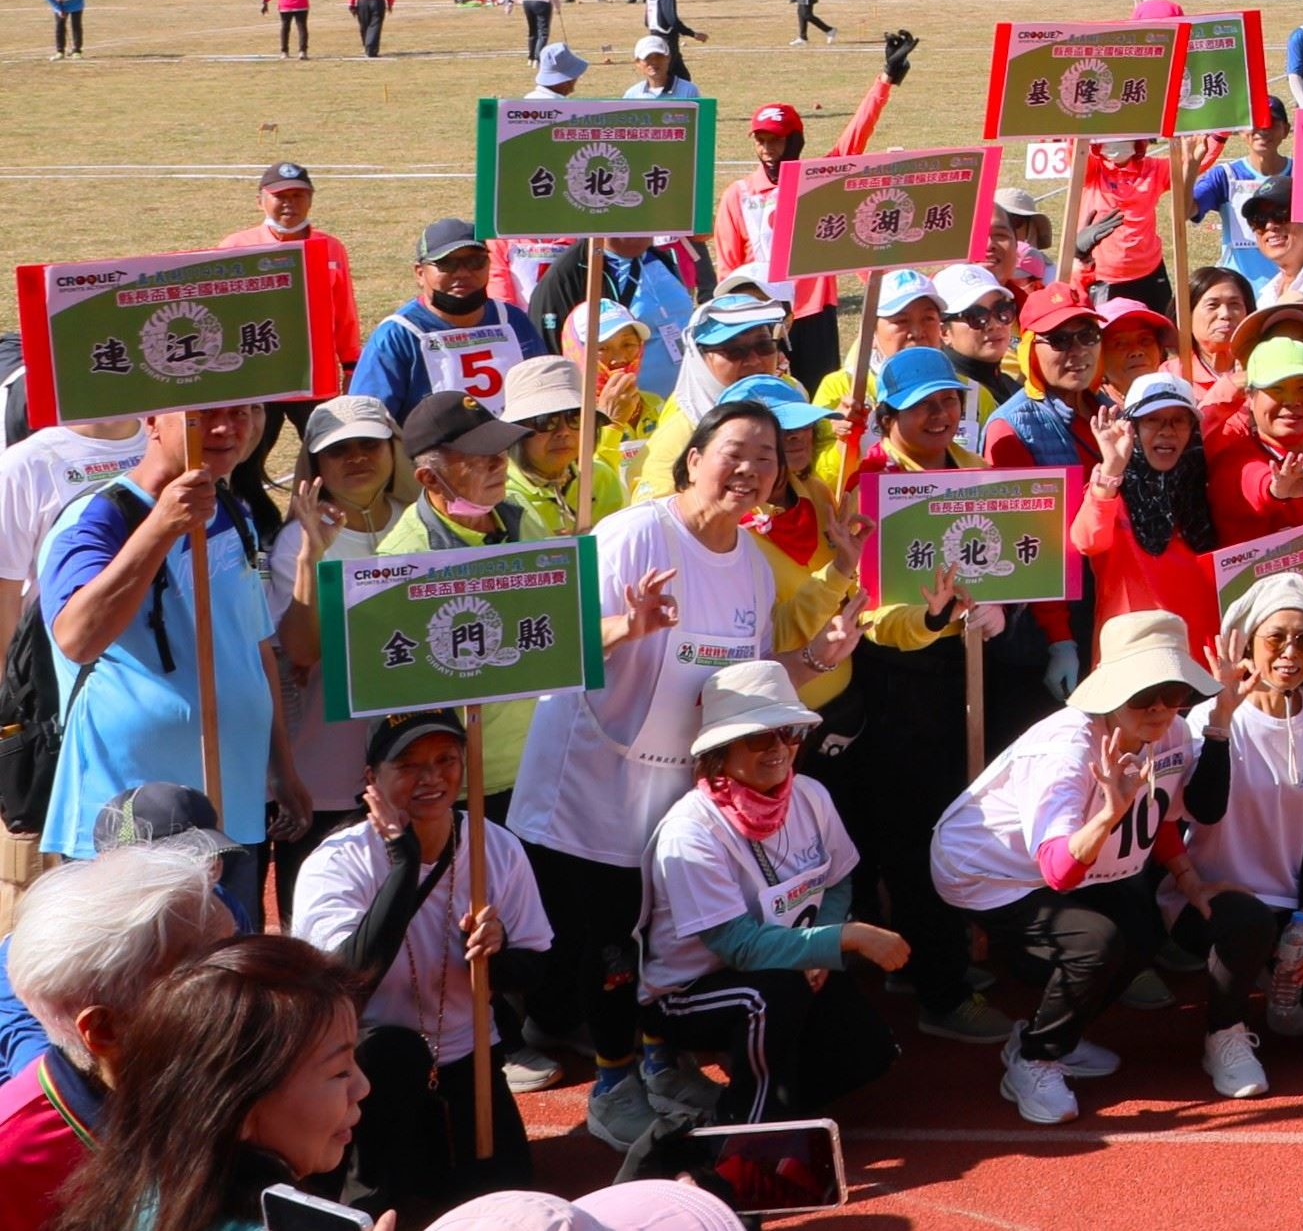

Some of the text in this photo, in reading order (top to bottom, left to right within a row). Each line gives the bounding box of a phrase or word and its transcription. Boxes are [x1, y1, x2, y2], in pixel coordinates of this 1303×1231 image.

[1018, 30, 1064, 40] CROQUET
[1027, 78, 1148, 106] 基隆縣
[1201, 71, 1229, 99] 縣
[507, 109, 562, 120] CROQUET
[553, 127, 686, 141] 縣長盃暨全國槌球邀請賽
[575, 142, 621, 162] CHIAYI
[1031, 148, 1068, 175] 03
[529, 166, 671, 198] 台北市
[805, 163, 857, 176] CROQUET
[815, 204, 954, 241] 澎湖縣
[57, 270, 128, 288] CROQUET
[117, 273, 292, 307] 縣長盃暨全國槌球邀請賽
[150, 301, 208, 328] CHIAYI
[92, 319, 281, 374] 連江縣
[460, 349, 503, 399] 5
[888, 484, 938, 496] CROQUET
[929, 497, 1055, 515] 縣長盃暨全國槌球邀請賽
[906, 534, 1041, 570] 新北市
[1221, 548, 1260, 568] CROQUET
[354, 564, 419, 580] CROQUET
[408, 570, 566, 600] 縣長盃暨全國槌球邀請賽
[437, 595, 489, 620] CHIAYI
[382, 614, 555, 669] 金門縣
[1111, 784, 1170, 861] 10
